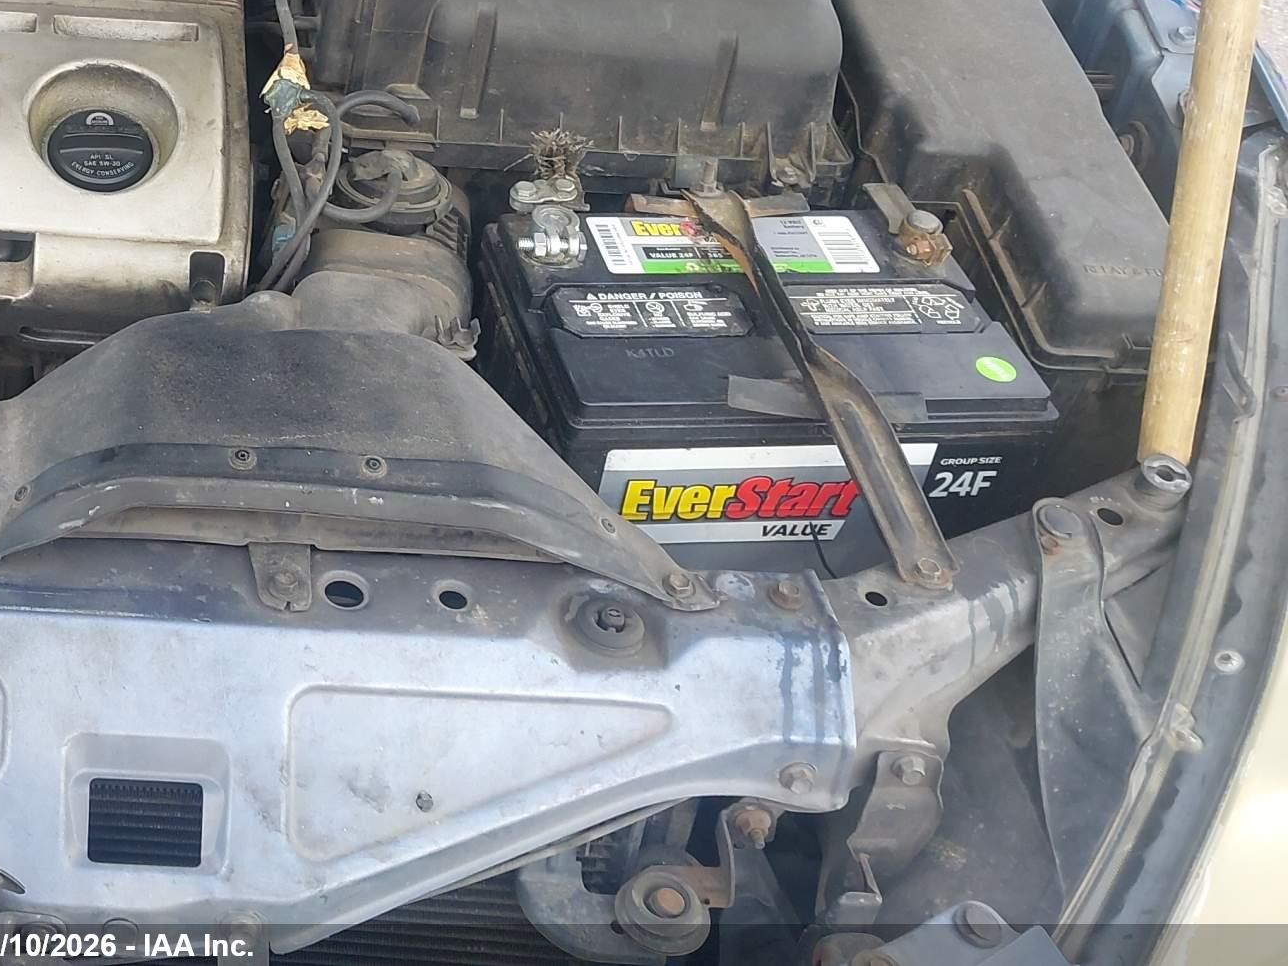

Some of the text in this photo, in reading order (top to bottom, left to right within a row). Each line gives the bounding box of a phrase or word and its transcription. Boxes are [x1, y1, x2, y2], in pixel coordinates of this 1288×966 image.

[597, 292, 648, 300] DANGER
[658, 291, 703, 299] POISON
[940, 455, 1003, 466] GROUP SIZE
[928, 469, 998, 499] 24F
[618, 474, 860, 521] EverStart
[761, 523, 833, 538] VALUE
